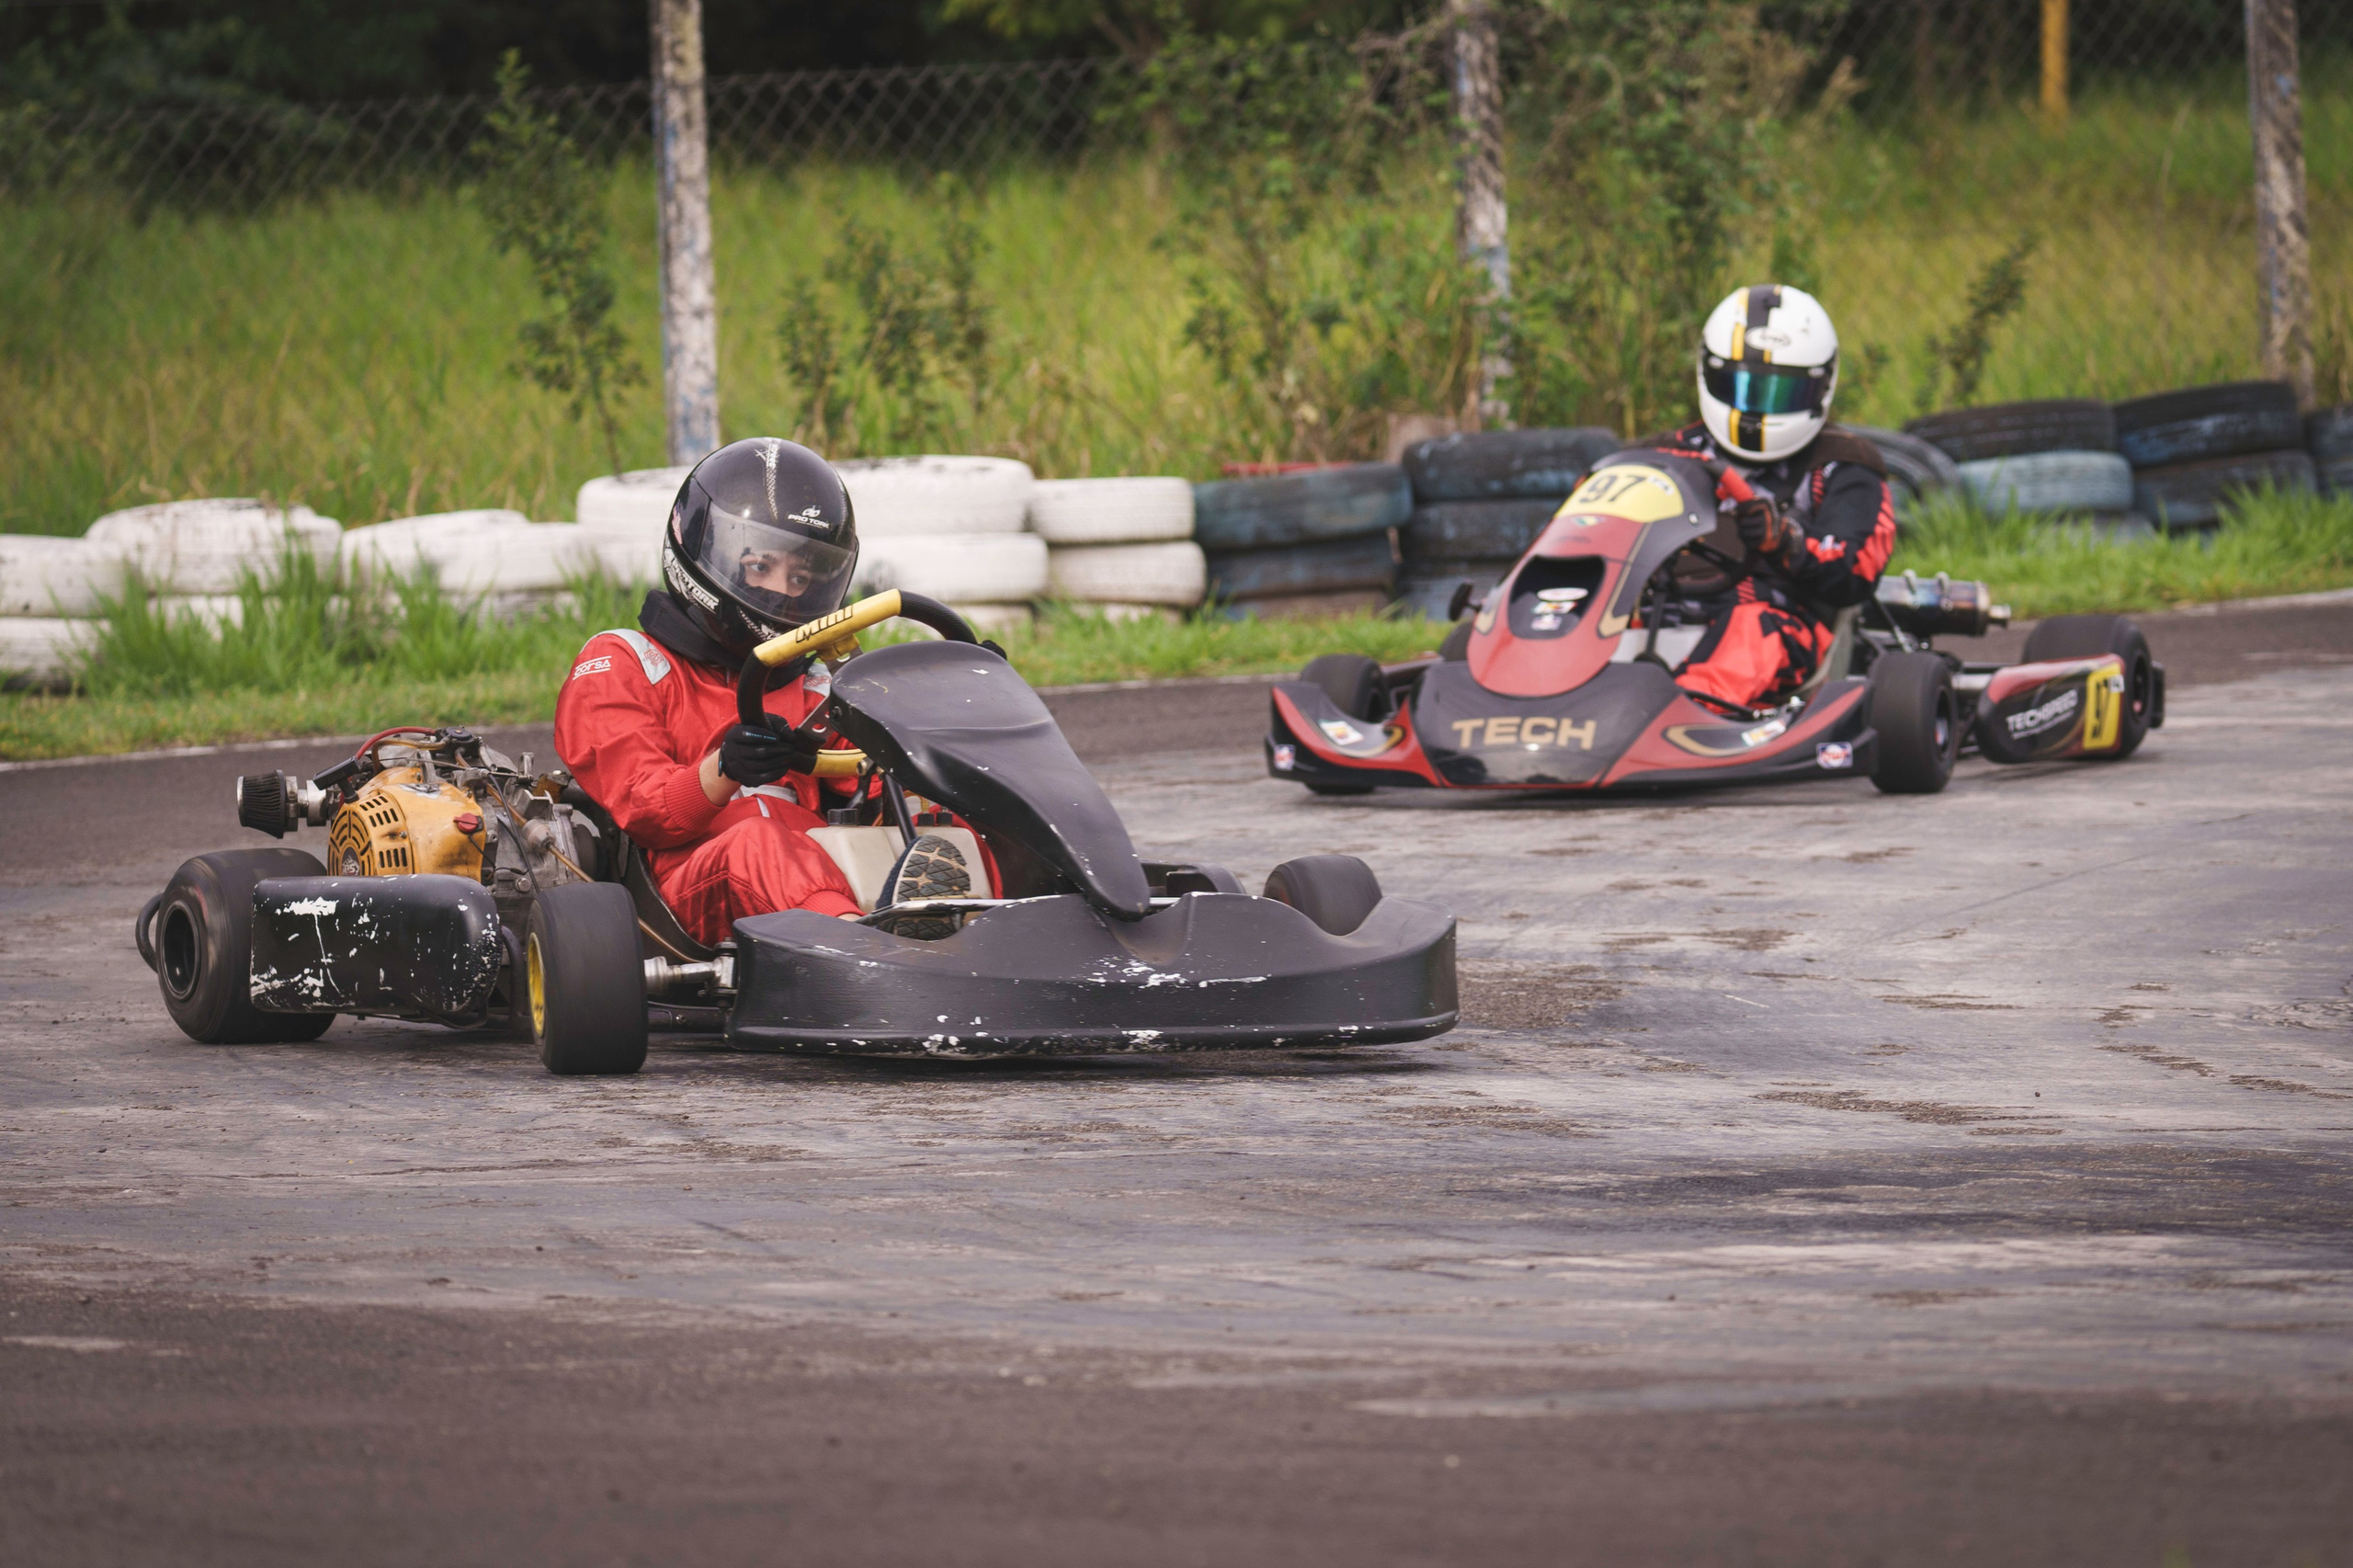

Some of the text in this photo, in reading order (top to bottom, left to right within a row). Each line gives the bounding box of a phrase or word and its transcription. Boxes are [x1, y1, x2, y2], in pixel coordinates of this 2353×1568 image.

[1578, 474, 1648, 504] 97
[788, 514, 809, 523] PRO
[809, 517, 830, 529] TORK
[688, 580, 719, 610] TORK
[1451, 716, 1597, 751] TECH
